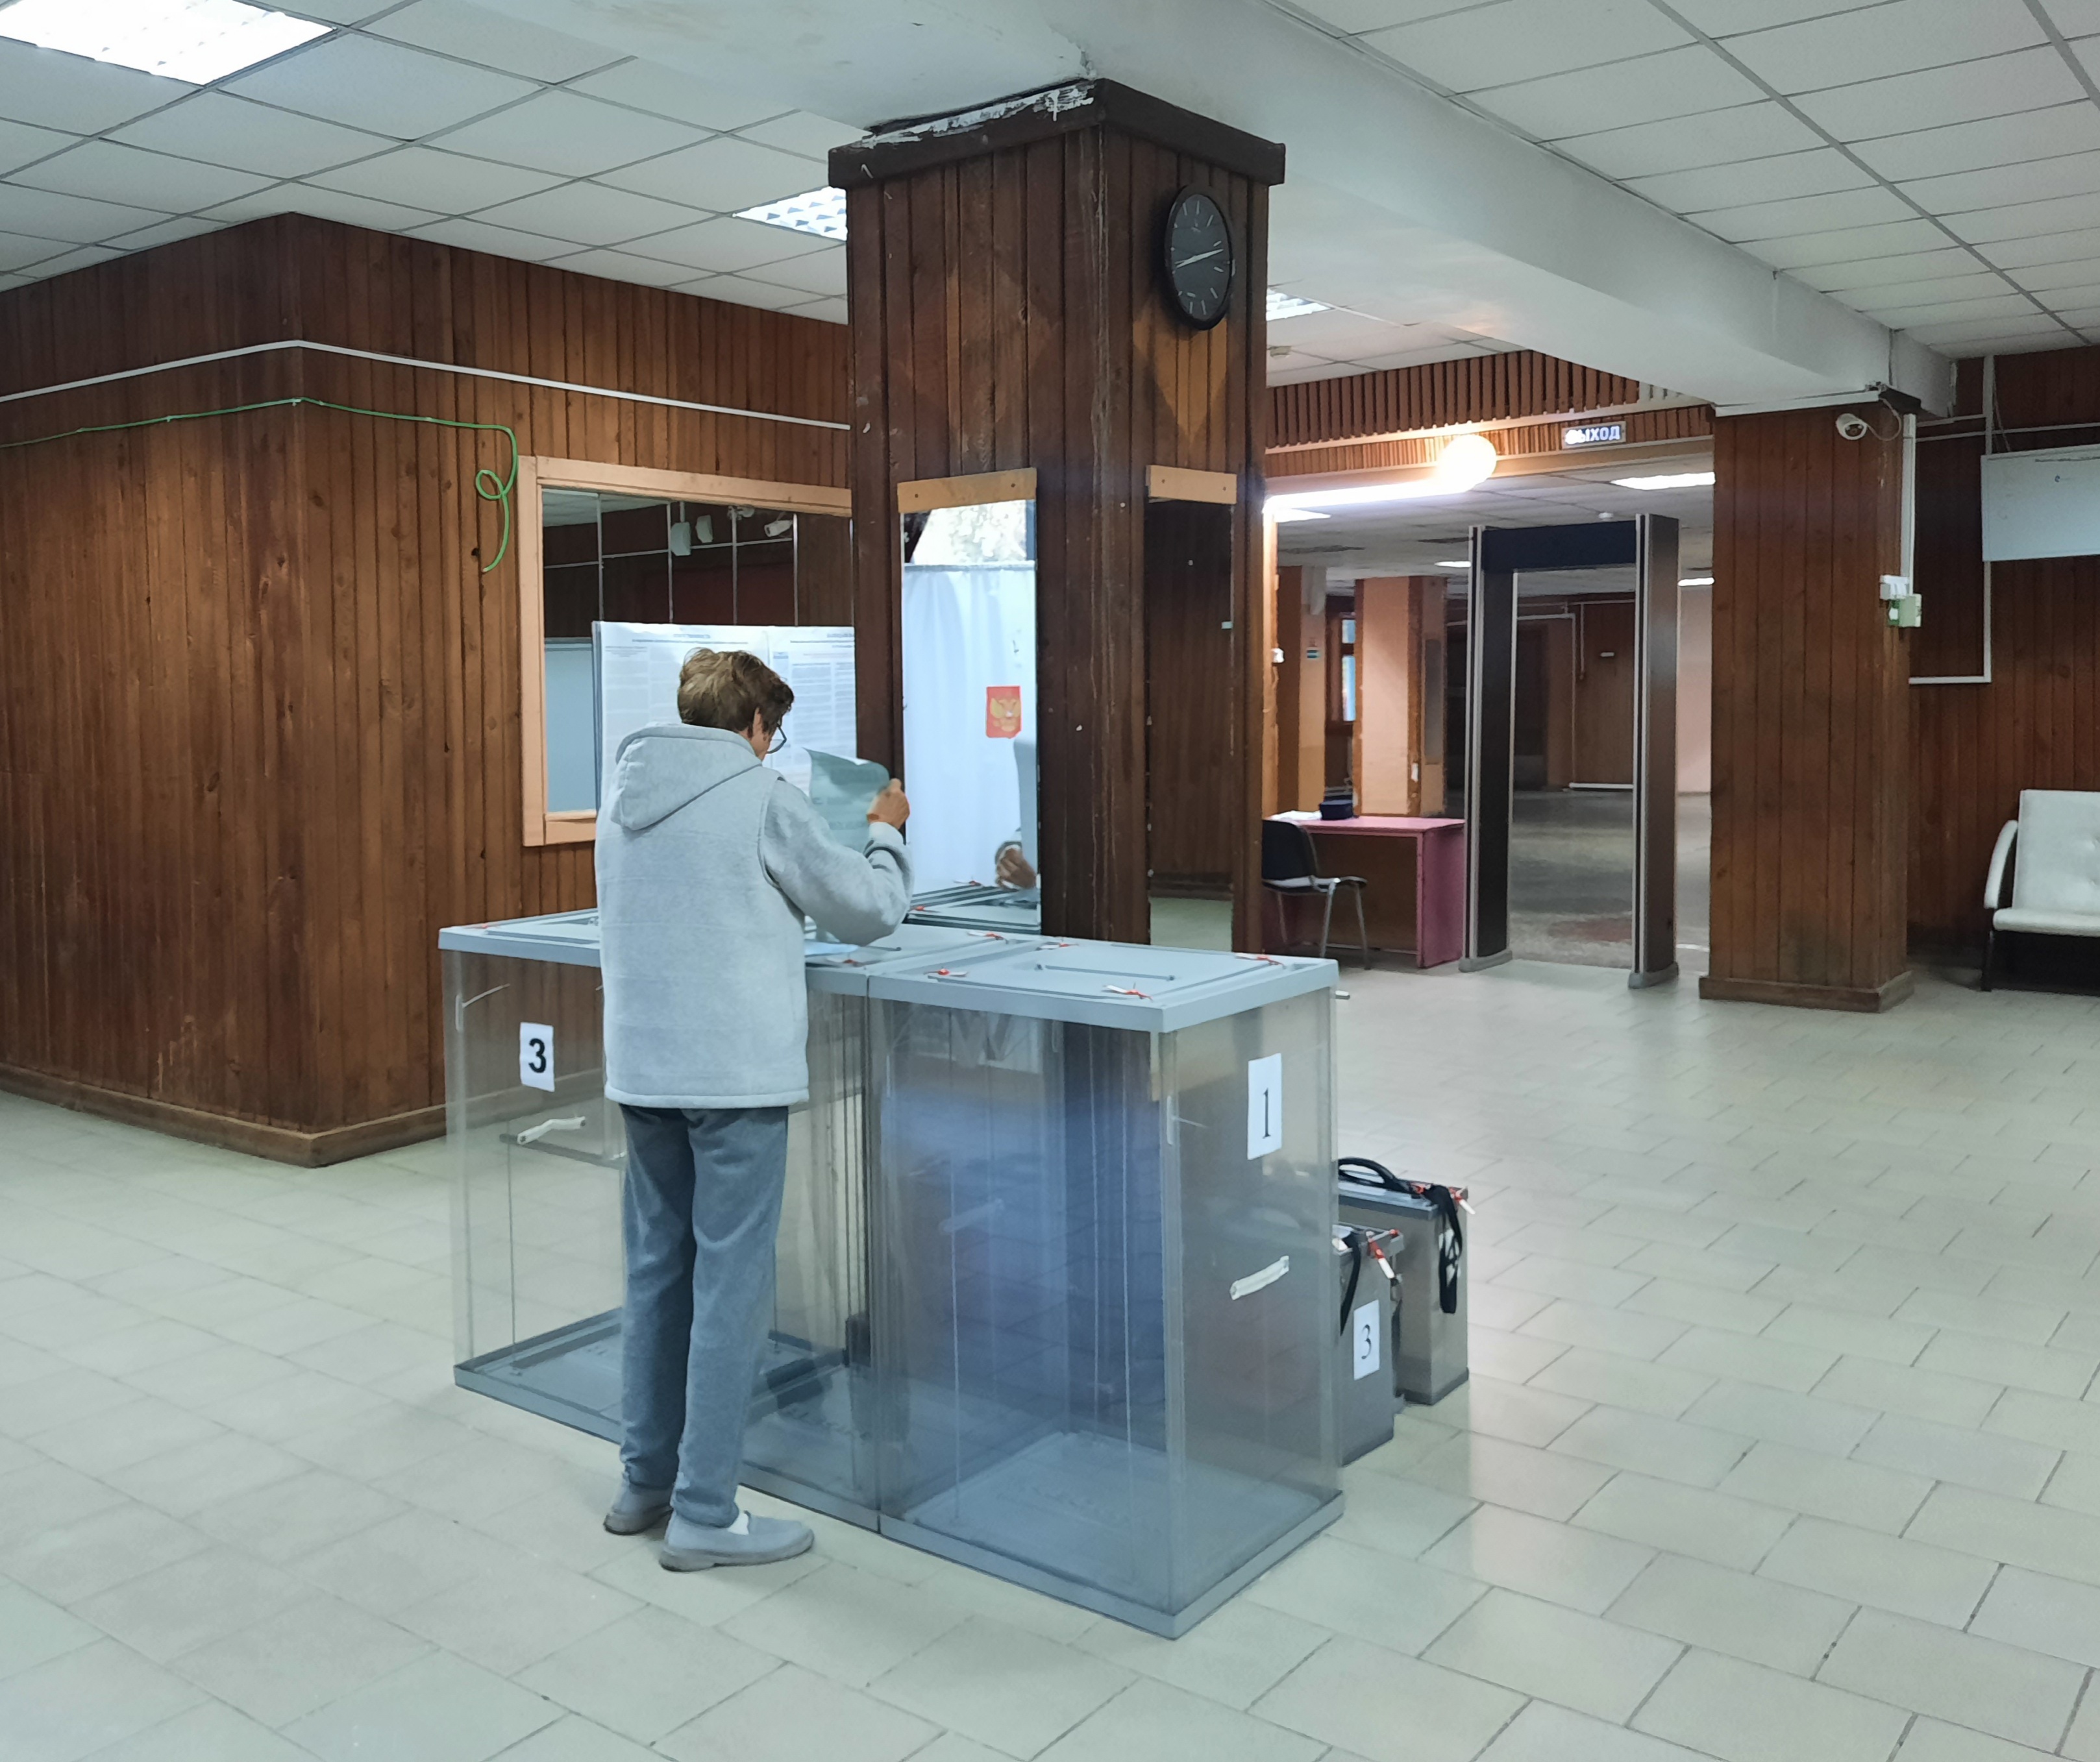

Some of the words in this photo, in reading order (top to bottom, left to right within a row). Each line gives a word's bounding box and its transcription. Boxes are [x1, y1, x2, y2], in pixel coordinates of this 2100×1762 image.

[1565, 426, 1620, 445] ЫХОД
[528, 1038, 547, 1073] 3
[1262, 1088, 1271, 1140] 1
[1361, 1324, 1372, 1360] 3
